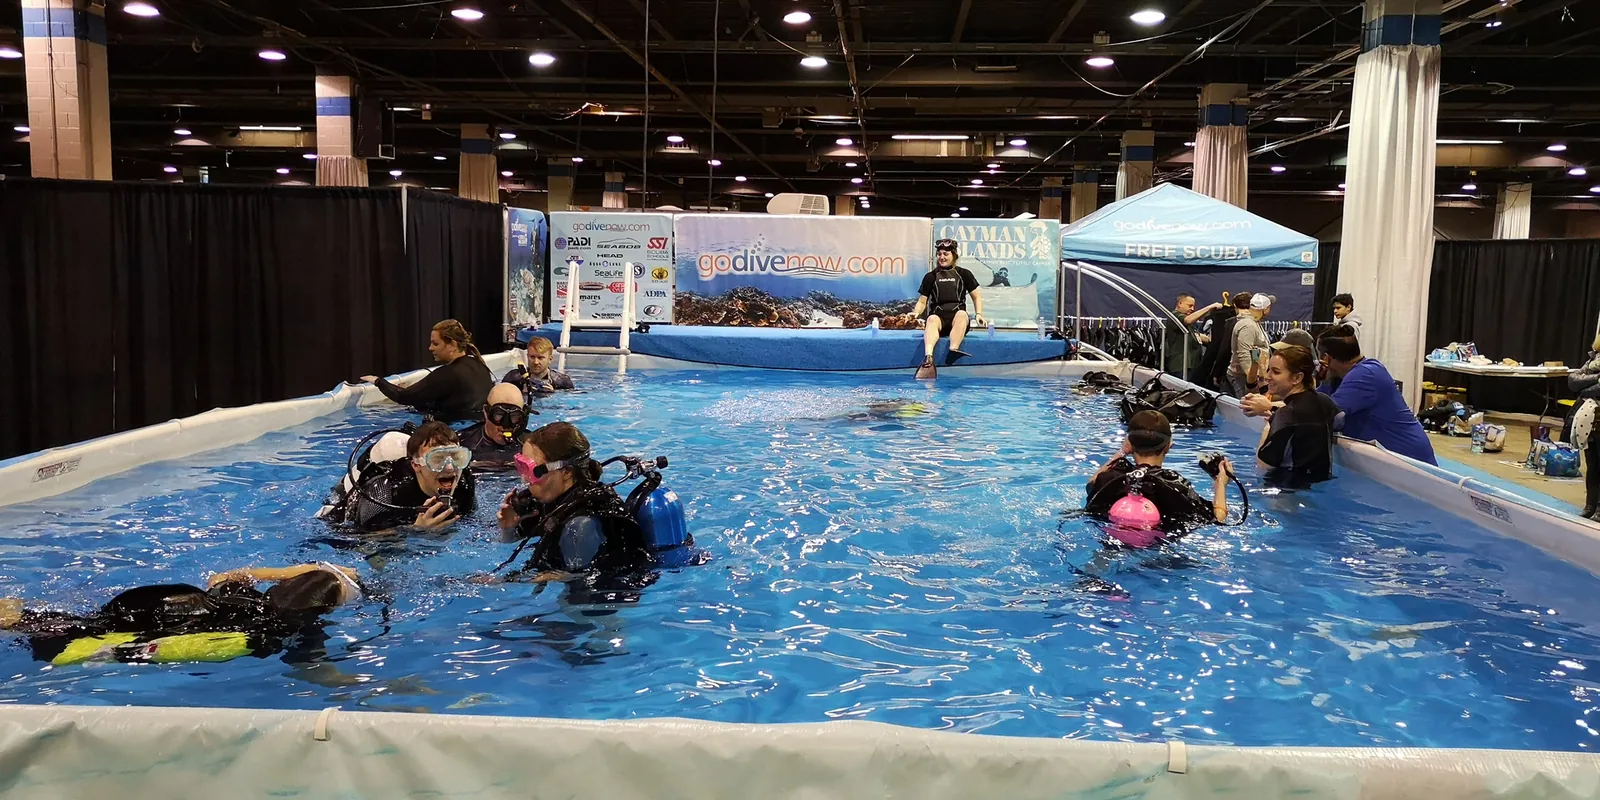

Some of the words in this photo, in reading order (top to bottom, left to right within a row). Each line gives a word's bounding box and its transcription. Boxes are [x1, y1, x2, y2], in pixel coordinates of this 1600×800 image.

[572, 222, 650, 233] godivenow.com
[1113, 217, 1252, 232] godivenow.com
[939, 225, 1029, 243] CAYMAN
[568, 237, 591, 247] PADI
[647, 237, 669, 250] SSI
[957, 242, 1028, 260] LANDS
[1124, 243, 1177, 259] FREE
[1183, 245, 1252, 260] SCUBA
[698, 248, 905, 277] godivenow.com
[594, 269, 624, 277] SeaLife
[643, 290, 667, 298] ADPA
